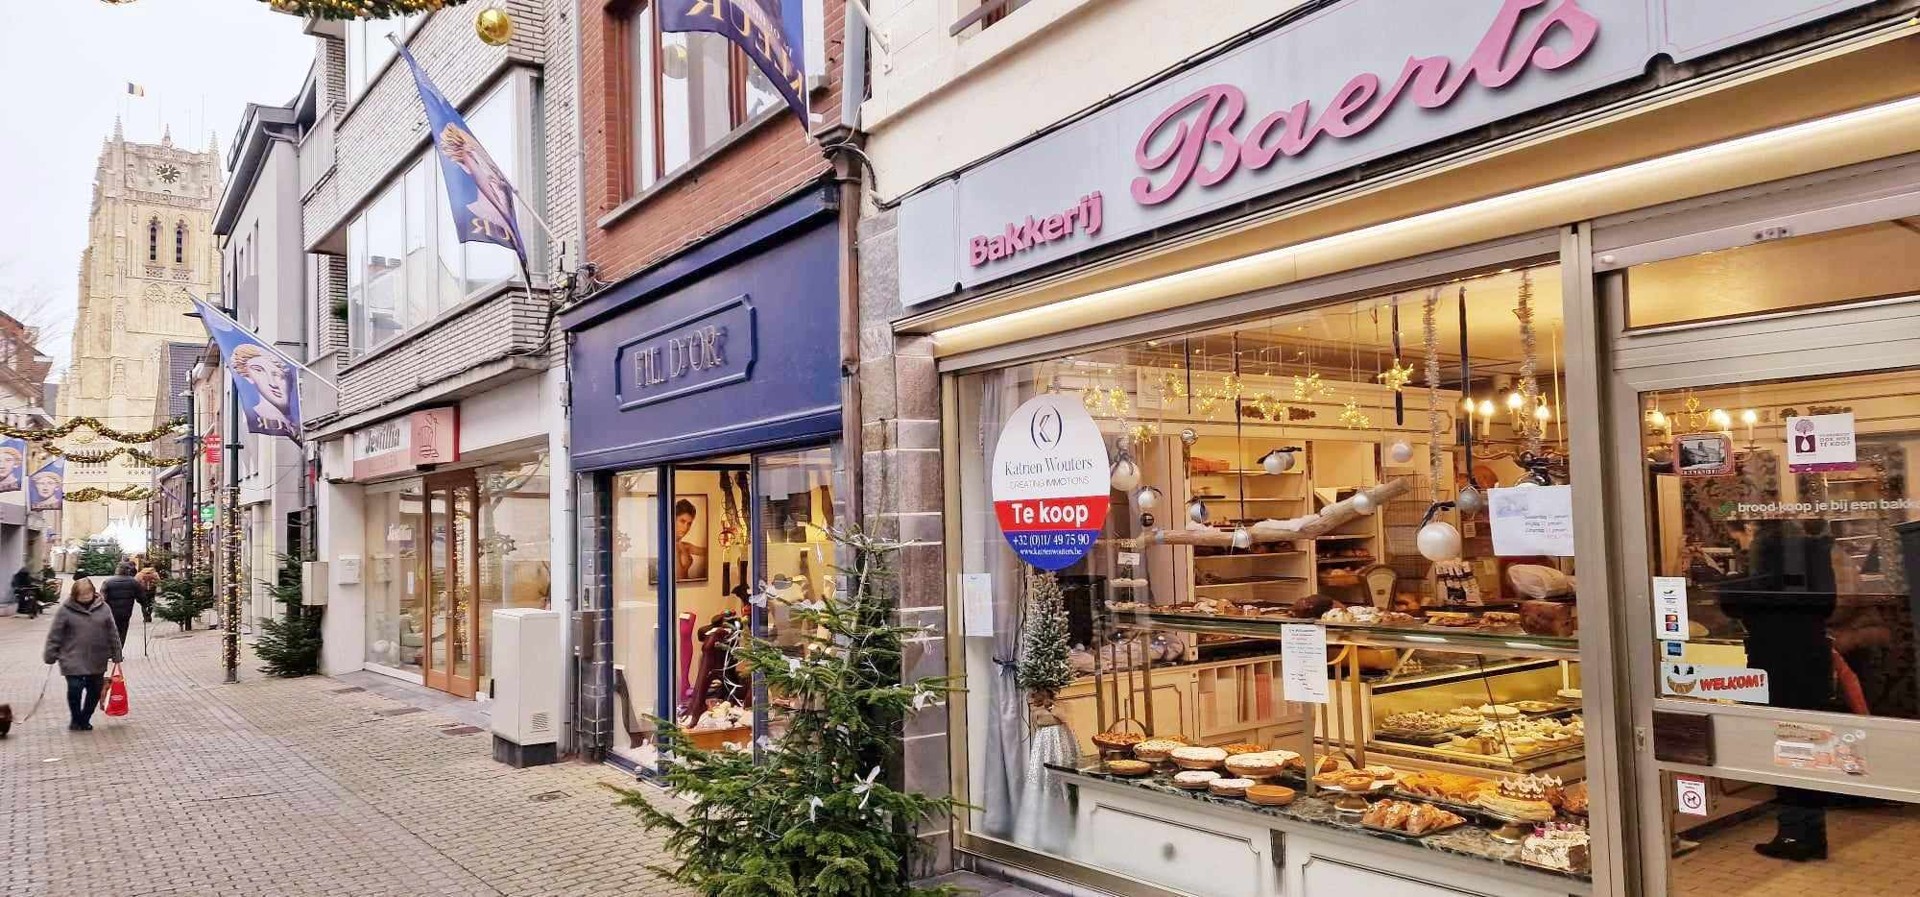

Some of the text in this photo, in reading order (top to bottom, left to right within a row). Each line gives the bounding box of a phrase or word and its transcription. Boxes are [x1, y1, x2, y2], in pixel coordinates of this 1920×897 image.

[1130, 0, 1599, 205] Baerts
[969, 190, 1103, 267] Bakkerij
[634, 346, 665, 388] FIL
[1005, 457, 1093, 476] Katrien Wouters
[1011, 501, 1089, 528] Te koop
[1815, 500, 1828, 513] je
[1830, 499, 1848, 512] bij
[1850, 501, 1877, 510] een
[1013, 535, 1027, 546] +32
[1053, 534, 1064, 546] 49
[1065, 534, 1076, 545] 75
[1077, 533, 1090, 545] 90
[1699, 674, 1765, 692] WELKOM!
